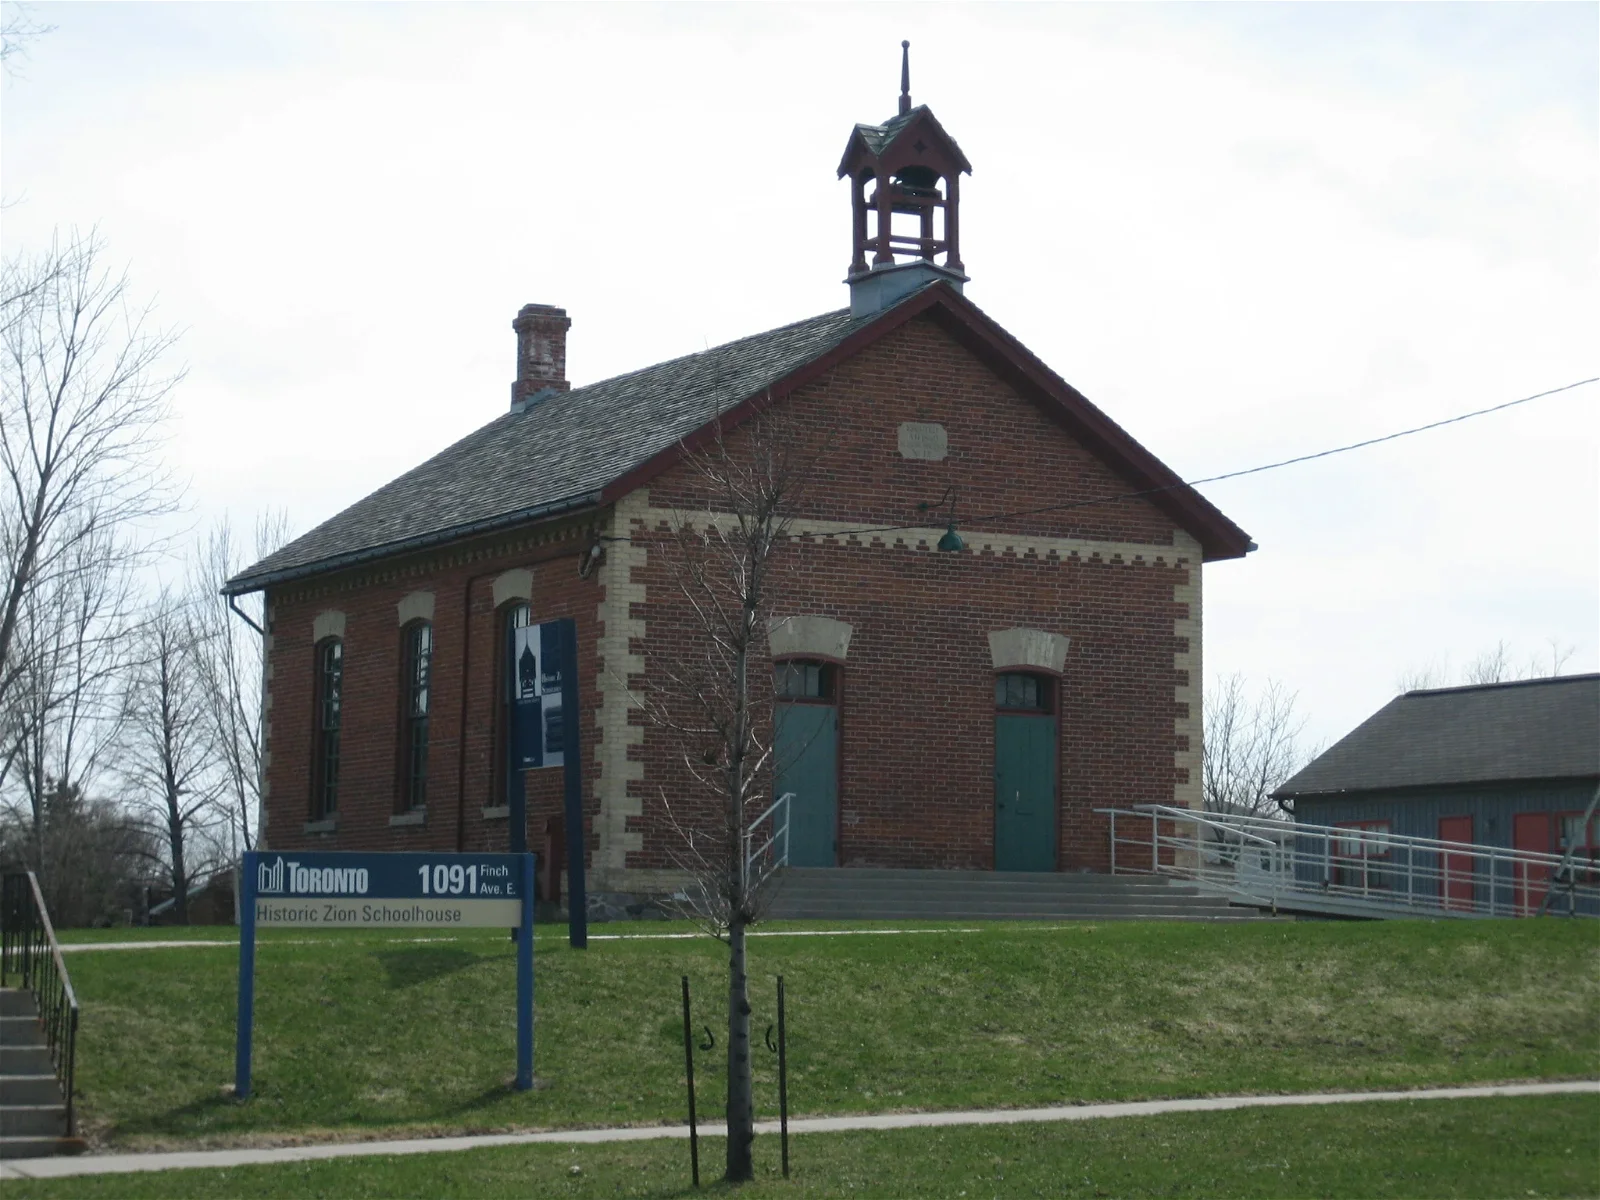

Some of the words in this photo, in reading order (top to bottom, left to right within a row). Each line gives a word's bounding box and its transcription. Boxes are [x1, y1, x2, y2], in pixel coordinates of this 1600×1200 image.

[287, 861, 369, 894] TORONTO
[418, 864, 477, 894] 1091
[480, 864, 509, 877] Finch
[480, 882, 503, 895] Ave.
[506, 882, 516, 895] E.
[256, 904, 318, 922] Historic
[323, 904, 357, 922] Zion
[362, 904, 462, 923] Schoolhouse
